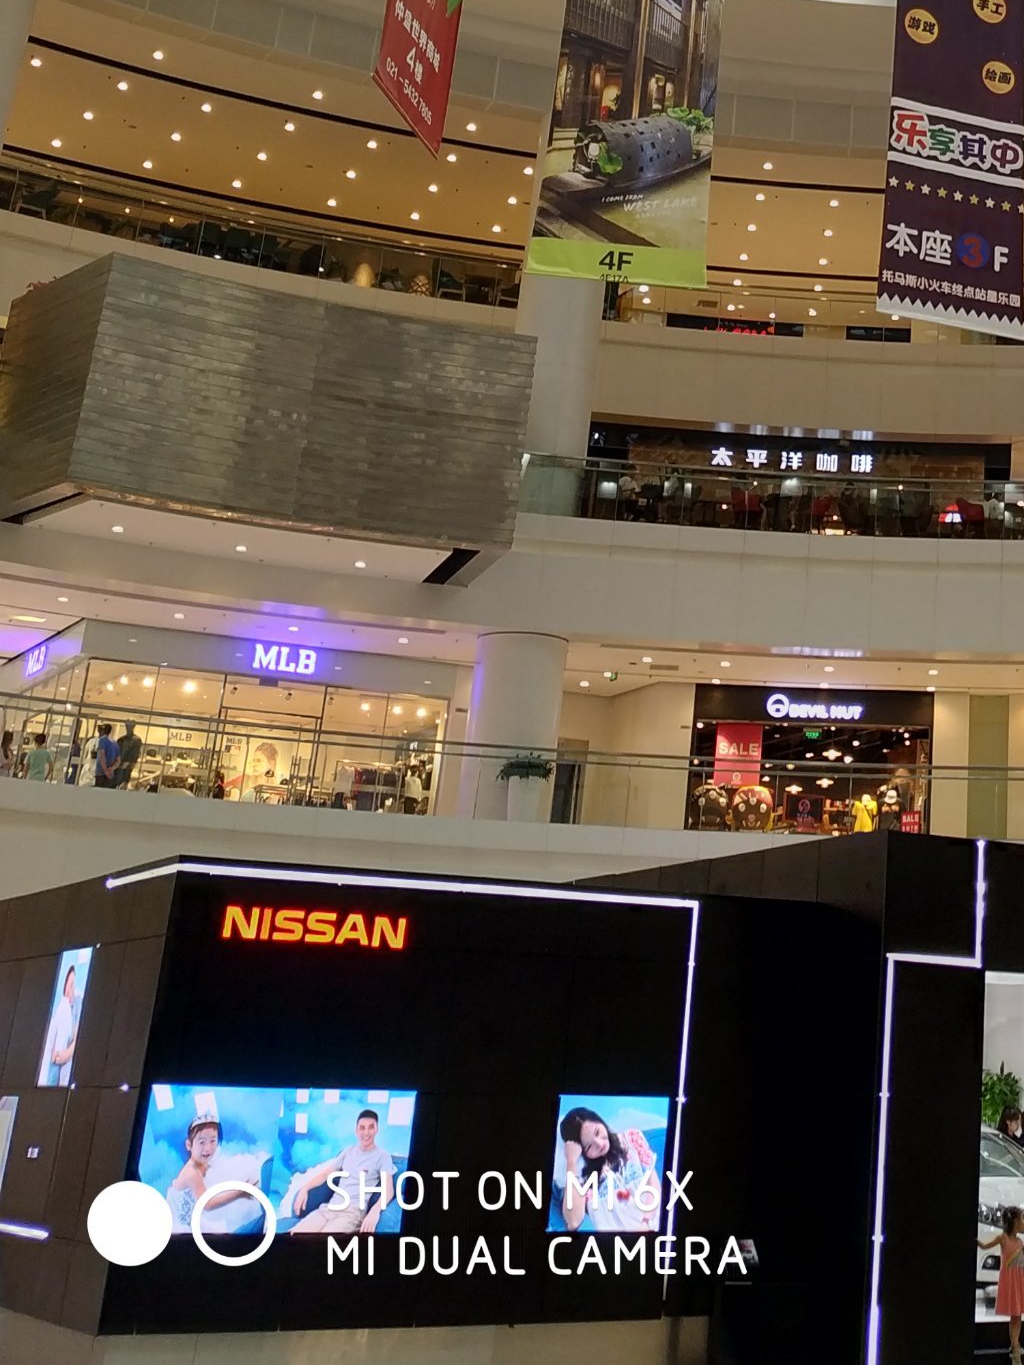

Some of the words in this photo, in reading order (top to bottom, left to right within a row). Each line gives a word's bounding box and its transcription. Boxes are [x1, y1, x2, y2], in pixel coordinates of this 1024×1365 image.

[977, 0, 1004, 16] 手工
[908, 16, 936, 35] 游戏
[985, 68, 1012, 85] 绘画
[893, 112, 1021, 171] 乐享其中
[624, 201, 660, 211] WEST
[664, 196, 697, 208] LAKE
[599, 250, 633, 271] 4F
[881, 269, 1021, 307] 托马斯小火车终点站星乐园
[711, 447, 874, 473] 太平洋咖啡
[252, 643, 317, 675] MLB
[789, 703, 829, 719] DEVIL
[830, 705, 863, 720] NUT
[169, 731, 193, 742] MLB
[719, 742, 759, 756] SALE
[222, 905, 407, 949] NISSAN
